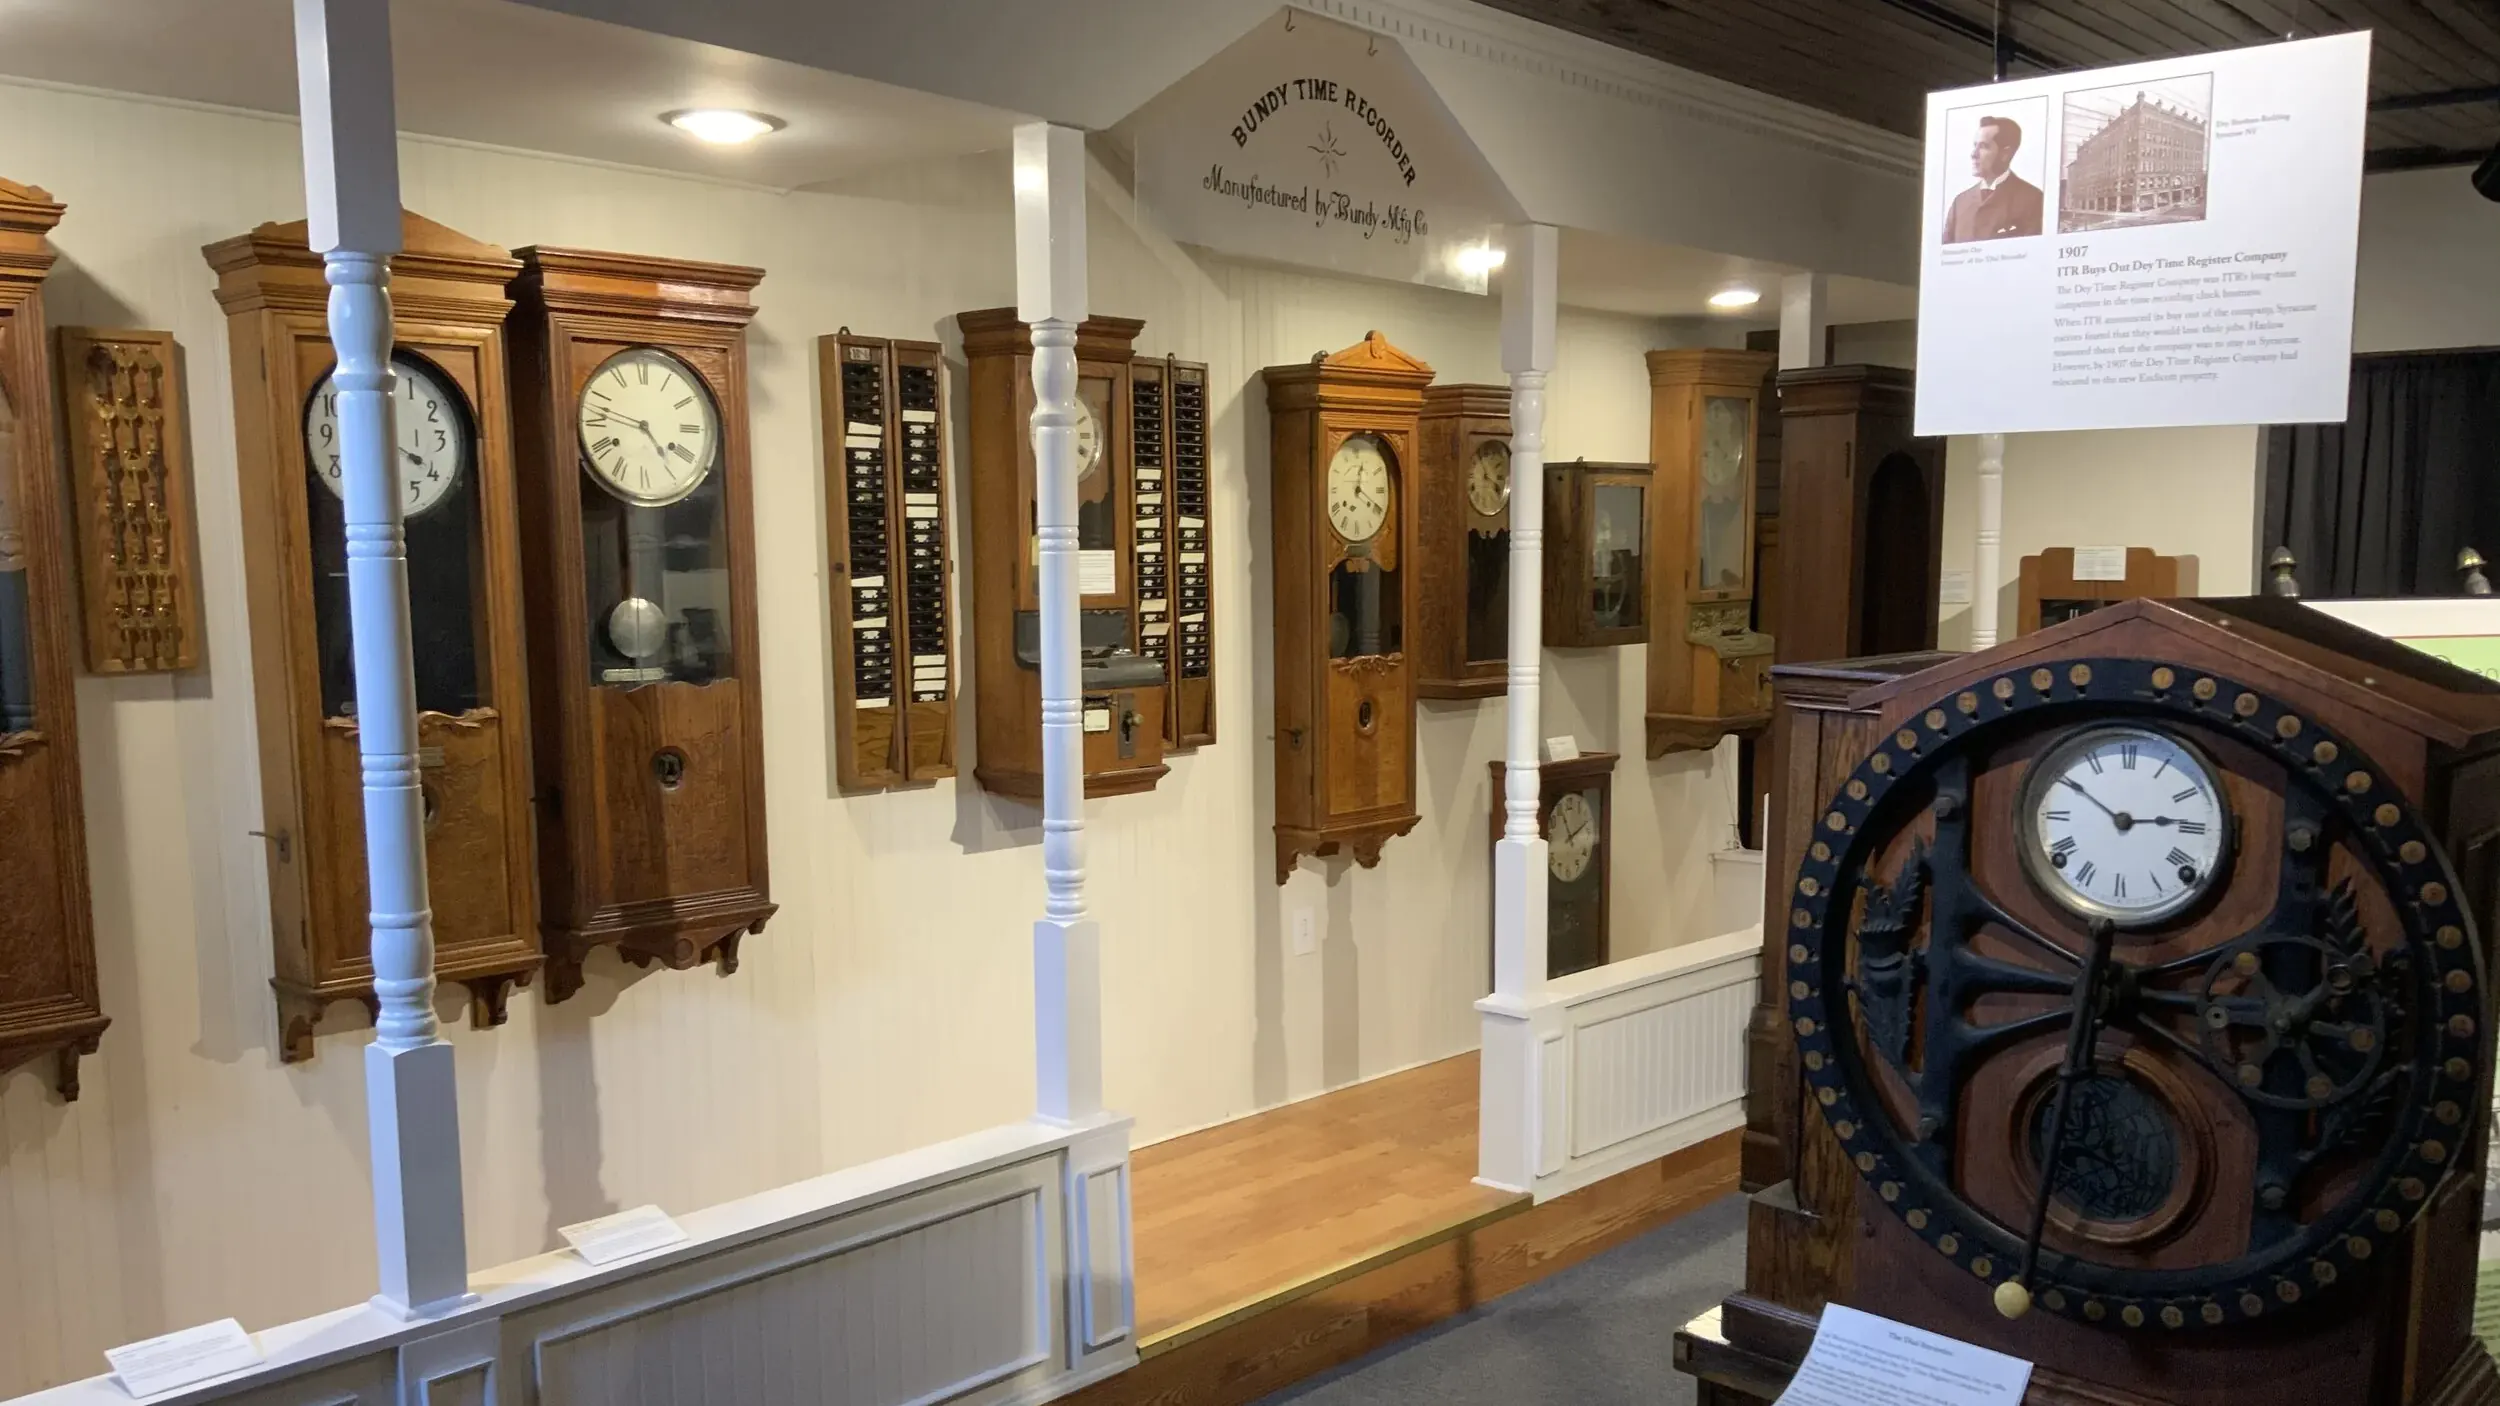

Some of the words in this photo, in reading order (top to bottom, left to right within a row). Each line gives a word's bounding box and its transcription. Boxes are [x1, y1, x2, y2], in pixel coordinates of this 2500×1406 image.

[1231, 82, 1288, 148] BUNDY
[1292, 78, 1339, 103] TIME
[1344, 88, 1416, 187] RECORDER
[1203, 163, 1307, 212] Manufactured
[1315, 189, 1330, 227] by
[1330, 191, 1379, 240] Bundy
[1382, 204, 1411, 244] Mfg
[1414, 209, 1428, 236] Co
[2058, 245, 2088, 259] 1907
[2057, 266, 2079, 277] ITR
[2082, 264, 2106, 277] Buys
[2109, 262, 2130, 273] Out
[2132, 259, 2153, 273] Dey
[2155, 258, 2184, 269] Time
[2187, 255, 2232, 268] Register
[2234, 251, 2288, 264] Company
[2074, 283, 2091, 295] Dey
[2094, 282, 2117, 292] Time
[2120, 280, 2155, 292] Register
[2157, 277, 2201, 289] Company
[2054, 317, 2081, 327] When
[2145, 356, 2164, 368] Dey
[407, 377, 414, 401] 1
[426, 400, 439, 423] 2
[320, 423, 333, 449] 9
[434, 430, 446, 453] 3
[329, 454, 342, 478] 8
[426, 461, 440, 482] 4
[409, 481, 421, 503] 5
